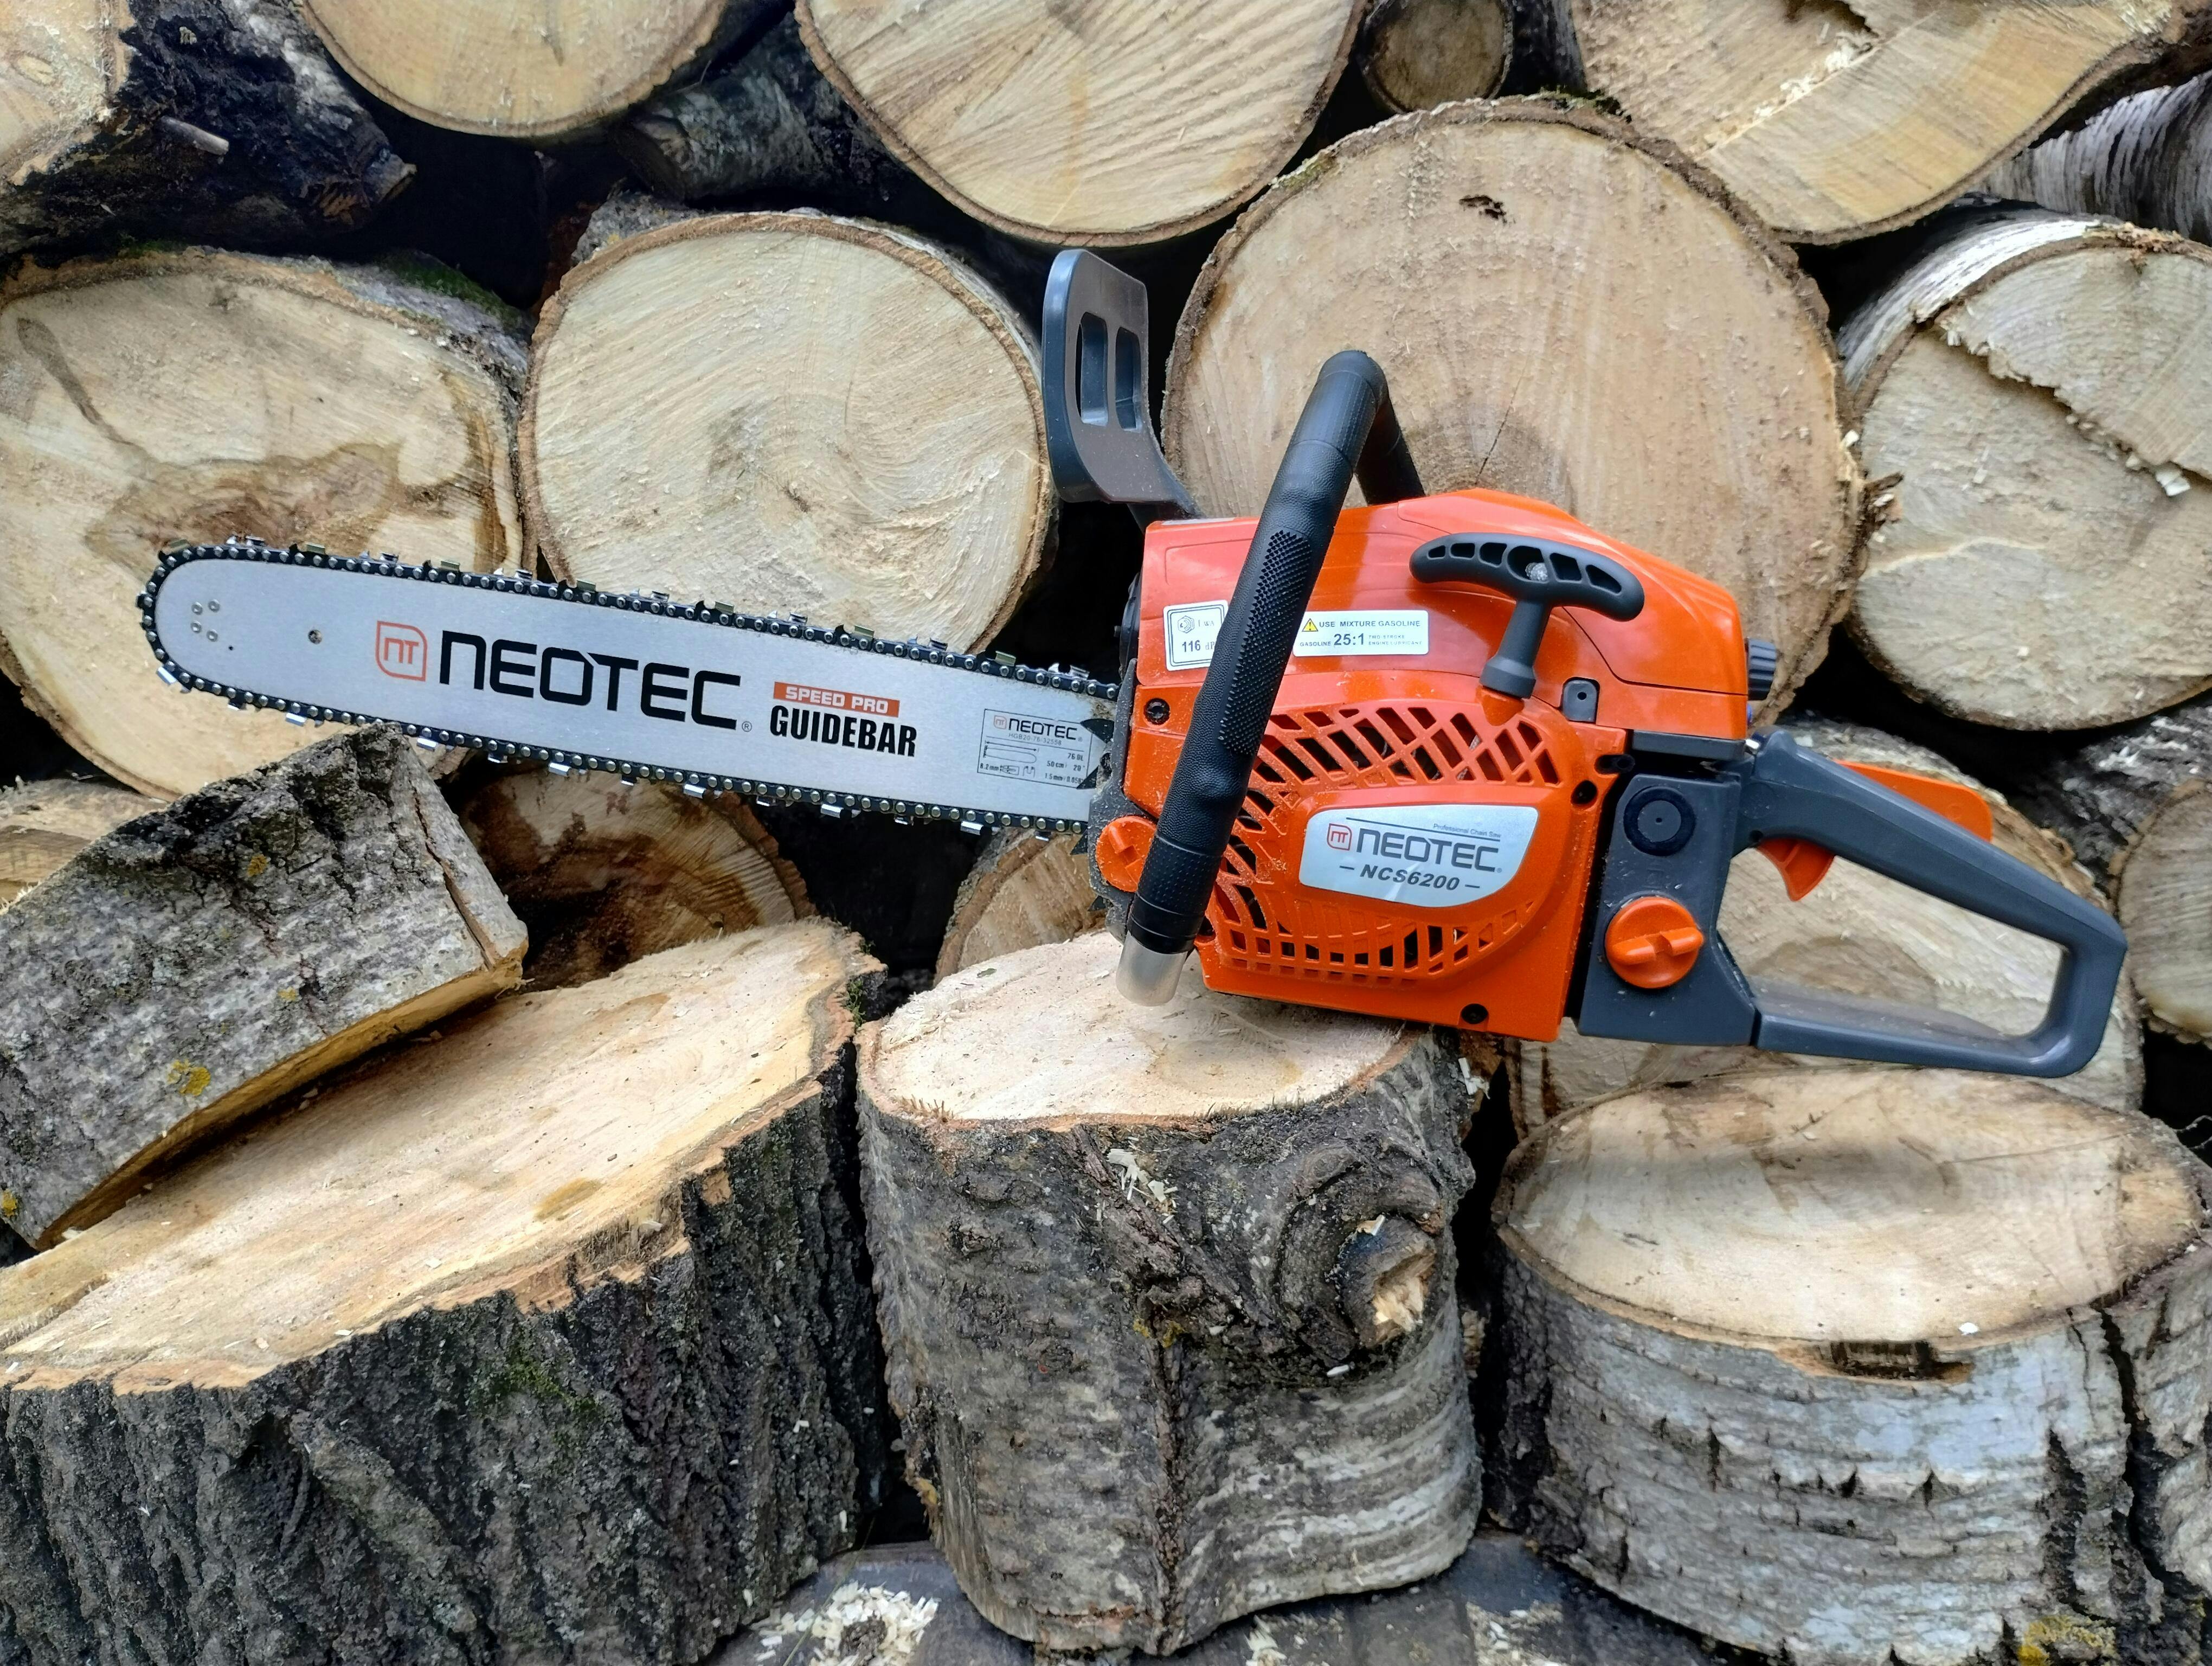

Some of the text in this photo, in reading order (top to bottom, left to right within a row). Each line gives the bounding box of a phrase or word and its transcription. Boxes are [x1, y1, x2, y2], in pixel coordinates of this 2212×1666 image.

[1182, 640, 1201, 652] 116
[1334, 633, 1364, 646] 25:1
[785, 686, 889, 714] SPEED PRO
[770, 705, 917, 758] GUIDEBAR
[1433, 823, 1469, 834] Professional
[1470, 829, 1488, 837] Chain
[1360, 864, 1459, 890] NCS6200
